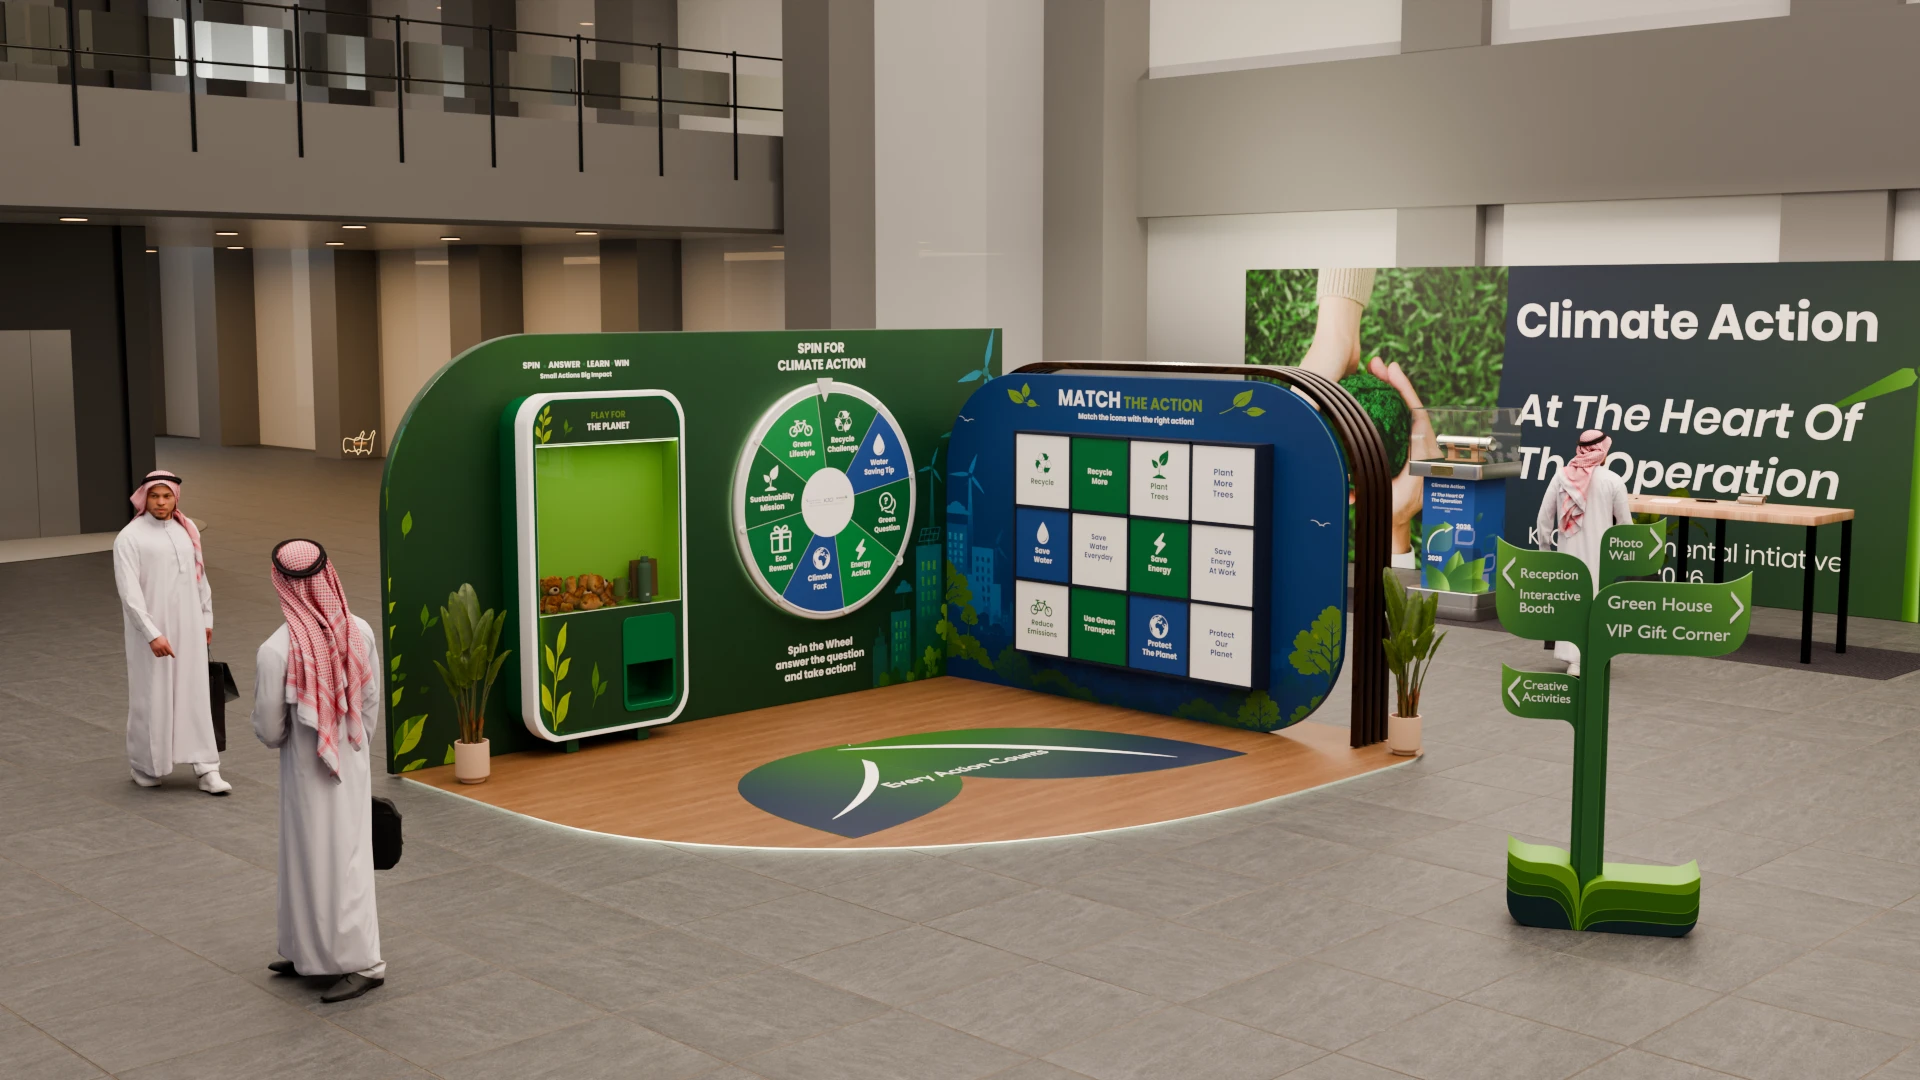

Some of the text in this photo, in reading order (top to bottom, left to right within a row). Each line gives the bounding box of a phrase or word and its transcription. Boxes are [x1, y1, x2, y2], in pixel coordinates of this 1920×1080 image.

[1516, 298, 1879, 342] Climate Action
[798, 342, 844, 354] SPIN FOR
[548, 360, 580, 369] ANSWER
[614, 359, 629, 367] WIN
[778, 358, 866, 371] CLIMATE ACTION
[1058, 389, 1202, 412] MATCH THE ACTION
[591, 410, 626, 419] PLAY FOR
[1078, 412, 1194, 426] Match the icons with the right action!
[1515, 393, 1866, 442] At The Heart Of
[587, 420, 630, 431] THE PLANET
[830, 435, 854, 444] Recycle
[827, 444, 858, 453] Challenge
[789, 450, 815, 458] Lifestyle
[864, 466, 894, 476] Saving Tip
[1087, 468, 1112, 477] Recycle
[1214, 468, 1233, 477] Plant
[1518, 446, 1840, 500] Th Operation
[1031, 478, 1054, 487] Recycle
[1092, 478, 1108, 486] More
[1151, 483, 1168, 491] Plant
[750, 492, 794, 504] Sustainability
[1213, 490, 1234, 499] Trees
[760, 503, 784, 512] Mission
[874, 524, 900, 534] Question
[1090, 542, 1108, 551] Water
[1609, 536, 1643, 549] Photo
[1035, 547, 1050, 555] Save
[1529, 526, 1558, 545] KC
[1745, 544, 1841, 572] intiatve
[1034, 556, 1052, 564] Water
[1084, 552, 1113, 562] Everyday
[1151, 555, 1167, 564] Save
[1609, 550, 1635, 561] Wall
[769, 563, 793, 572] Reward
[851, 560, 871, 569] Energy
[1211, 558, 1234, 568] Energy
[852, 568, 871, 577] Action
[1148, 565, 1171, 576] Energy
[1218, 568, 1236, 576] Work
[1521, 568, 1579, 582] Reception
[808, 573, 832, 582] Climate
[813, 582, 827, 590] Fact
[1520, 589, 1581, 602] Interactive
[1519, 602, 1554, 614] Booth
[1608, 596, 1712, 613] Green House
[1031, 619, 1053, 628] Reduce
[1096, 616, 1115, 626] Green
[1028, 628, 1057, 638] Emissions
[1084, 625, 1115, 636] Transport
[1209, 629, 1234, 639] Protect
[1606, 624, 1731, 642] VIP Gift Corner
[788, 636, 853, 657] Spin the Wheel
[1148, 640, 1172, 650] Protect
[1142, 648, 1177, 660] The Planet
[1210, 649, 1232, 659] Planet
[776, 649, 864, 670] answer the question
[785, 662, 856, 682] and take action!
[1523, 679, 1568, 692] Creative
[1522, 692, 1571, 704] Activities
[881, 750, 1049, 788] Every Action Counts
